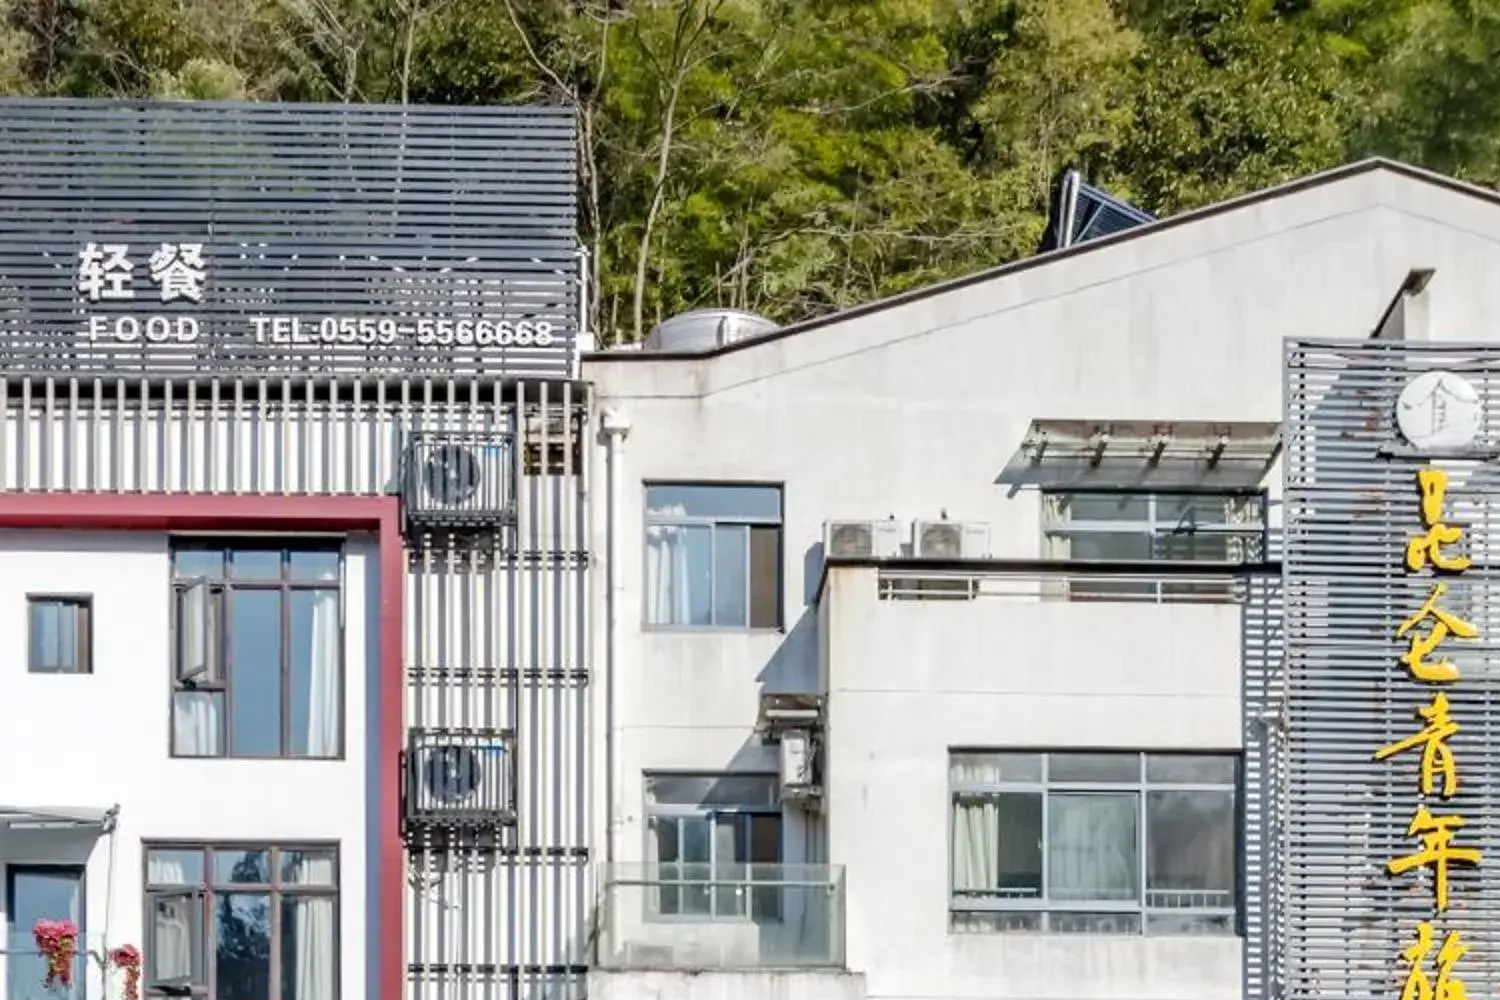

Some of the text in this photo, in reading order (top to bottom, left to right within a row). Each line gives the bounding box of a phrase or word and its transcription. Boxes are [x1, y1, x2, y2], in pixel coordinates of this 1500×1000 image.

[78, 242, 207, 300] 轻餐
[89, 316, 200, 342] FOOD
[249, 316, 555, 347] TEL:0559-5566668
